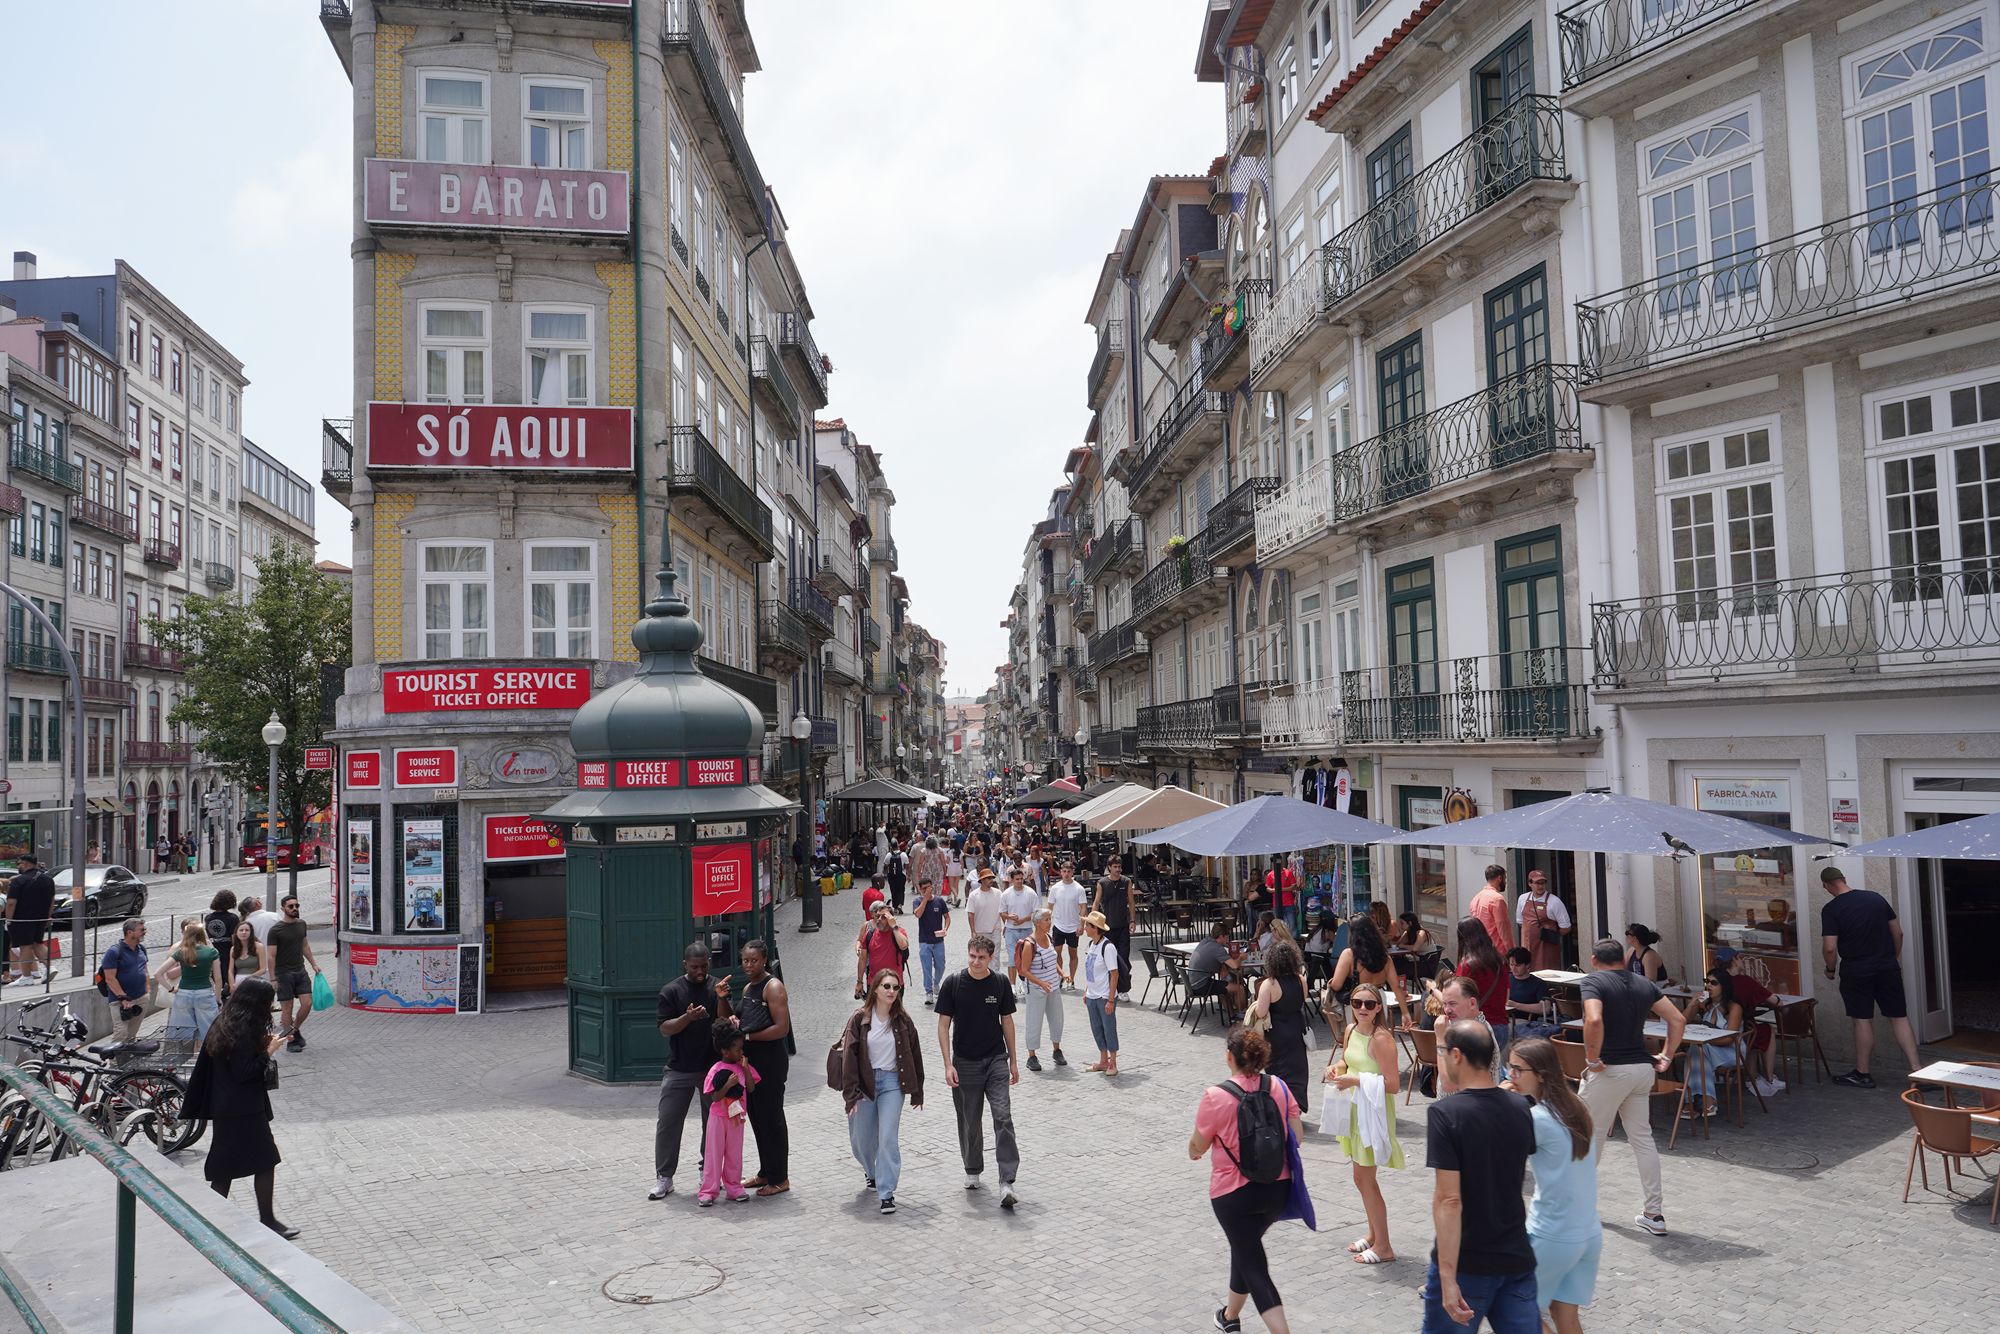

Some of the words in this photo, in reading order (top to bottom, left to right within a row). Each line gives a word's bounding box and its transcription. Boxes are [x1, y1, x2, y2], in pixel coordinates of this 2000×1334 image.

[439, 173, 608, 221] BARATO
[416, 408, 472, 458] SÓ
[489, 414, 587, 459] AQUI
[396, 672, 480, 693] TOURIST
[493, 672, 577, 690] SERVICE
[432, 692, 482, 707] TICKET
[486, 692, 538, 706] OFFICE
[353, 760, 369, 769] TICKET
[408, 757, 441, 766] TOURIST
[697, 760, 735, 771] TOURIST
[408, 768, 441, 778] SERVICE
[523, 766, 548, 775] travel
[584, 763, 605, 774] TOURIST
[626, 762, 667, 774] TICKET
[353, 770, 369, 779] OFFICE
[626, 773, 668, 785] OFFICE
[698, 771, 735, 783] SERVICE
[584, 775, 605, 786] SERVICE
[1750, 790, 1778, 799] NATA
[1833, 813, 1858, 821] Alarme
[494, 826, 523, 835] TICKET
[503, 834, 549, 842] INFORMATION
[711, 865, 734, 874] TICKET
[711, 873, 735, 883] OFFICE
